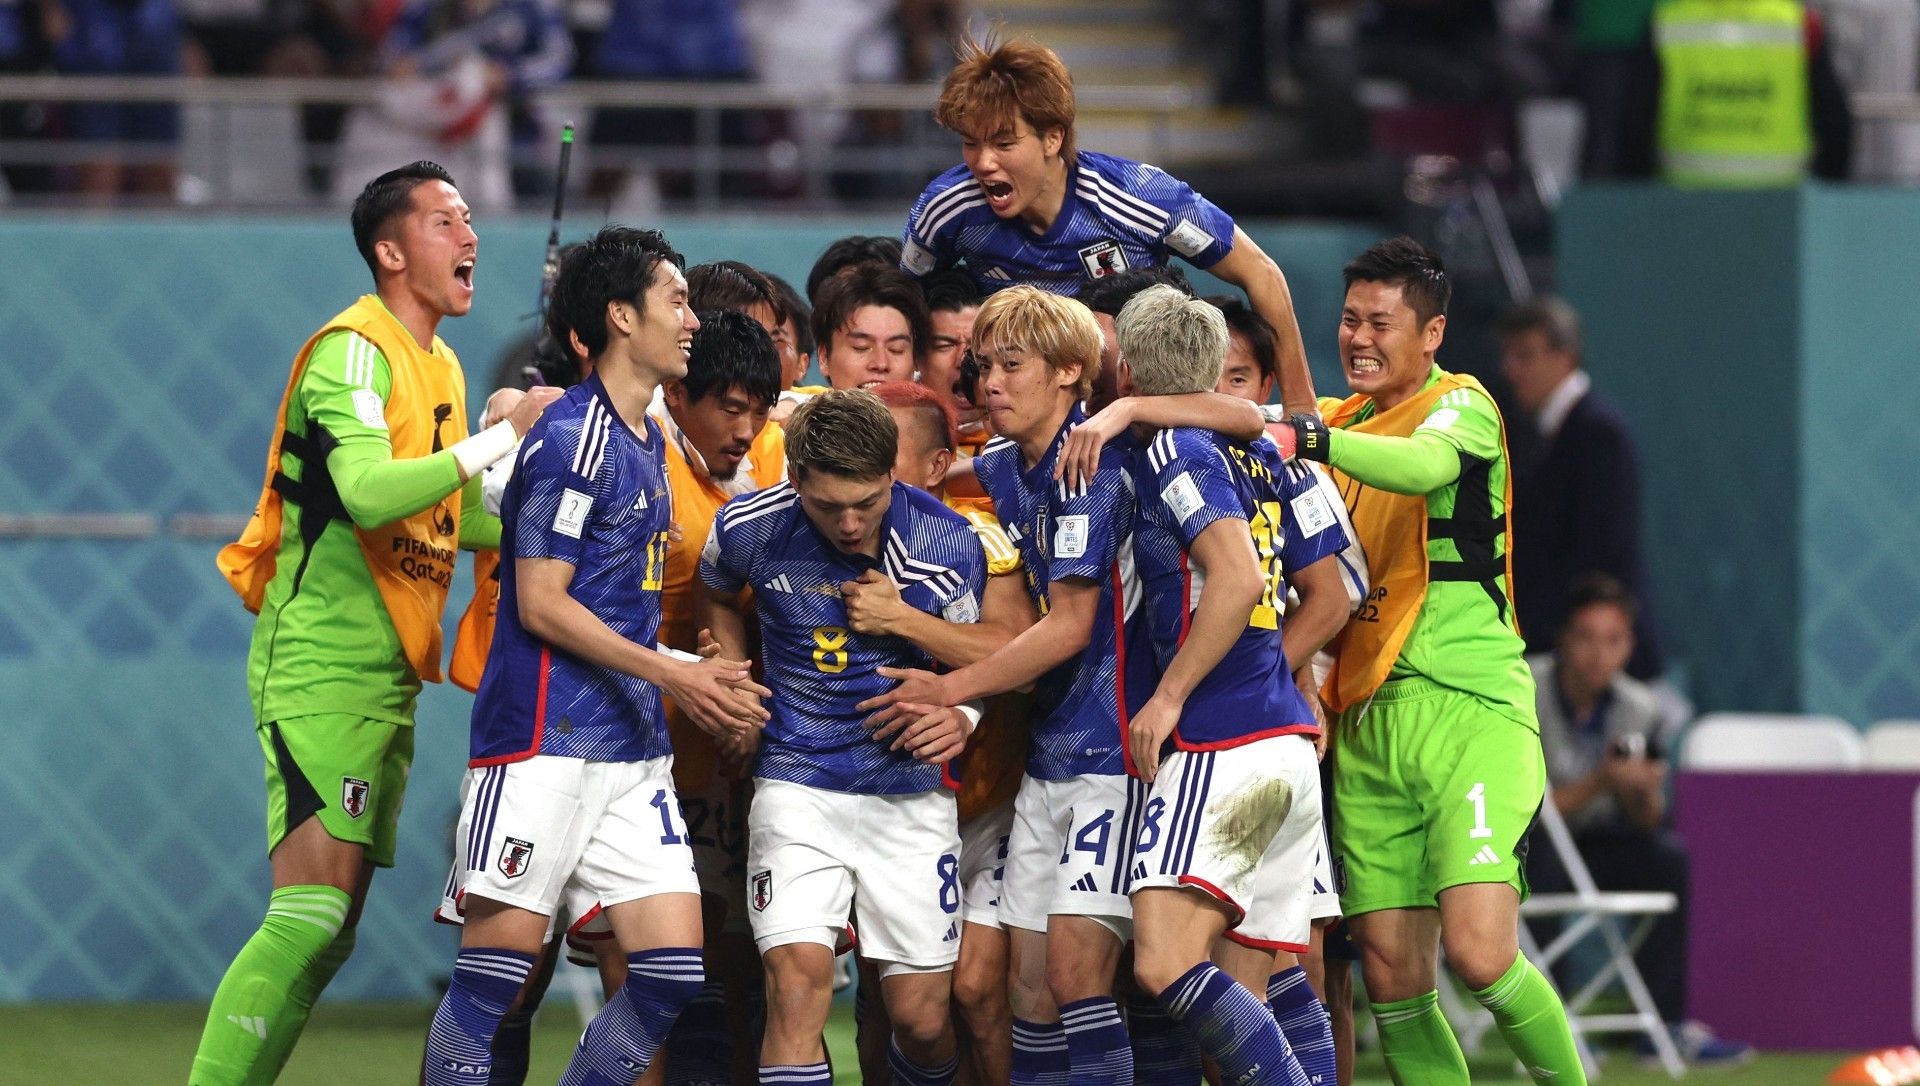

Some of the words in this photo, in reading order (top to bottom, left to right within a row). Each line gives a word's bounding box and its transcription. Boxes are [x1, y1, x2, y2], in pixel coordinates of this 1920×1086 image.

[1090, 243, 1110, 254] JAPAN
[1306, 432, 1317, 448] EIJI
[392, 537, 428, 558] FIFA
[812, 627, 849, 674] 8
[649, 788, 691, 846] 1
[1465, 782, 1493, 839] 1
[512, 838, 529, 847] JAPAN
[937, 853, 960, 914] 8
